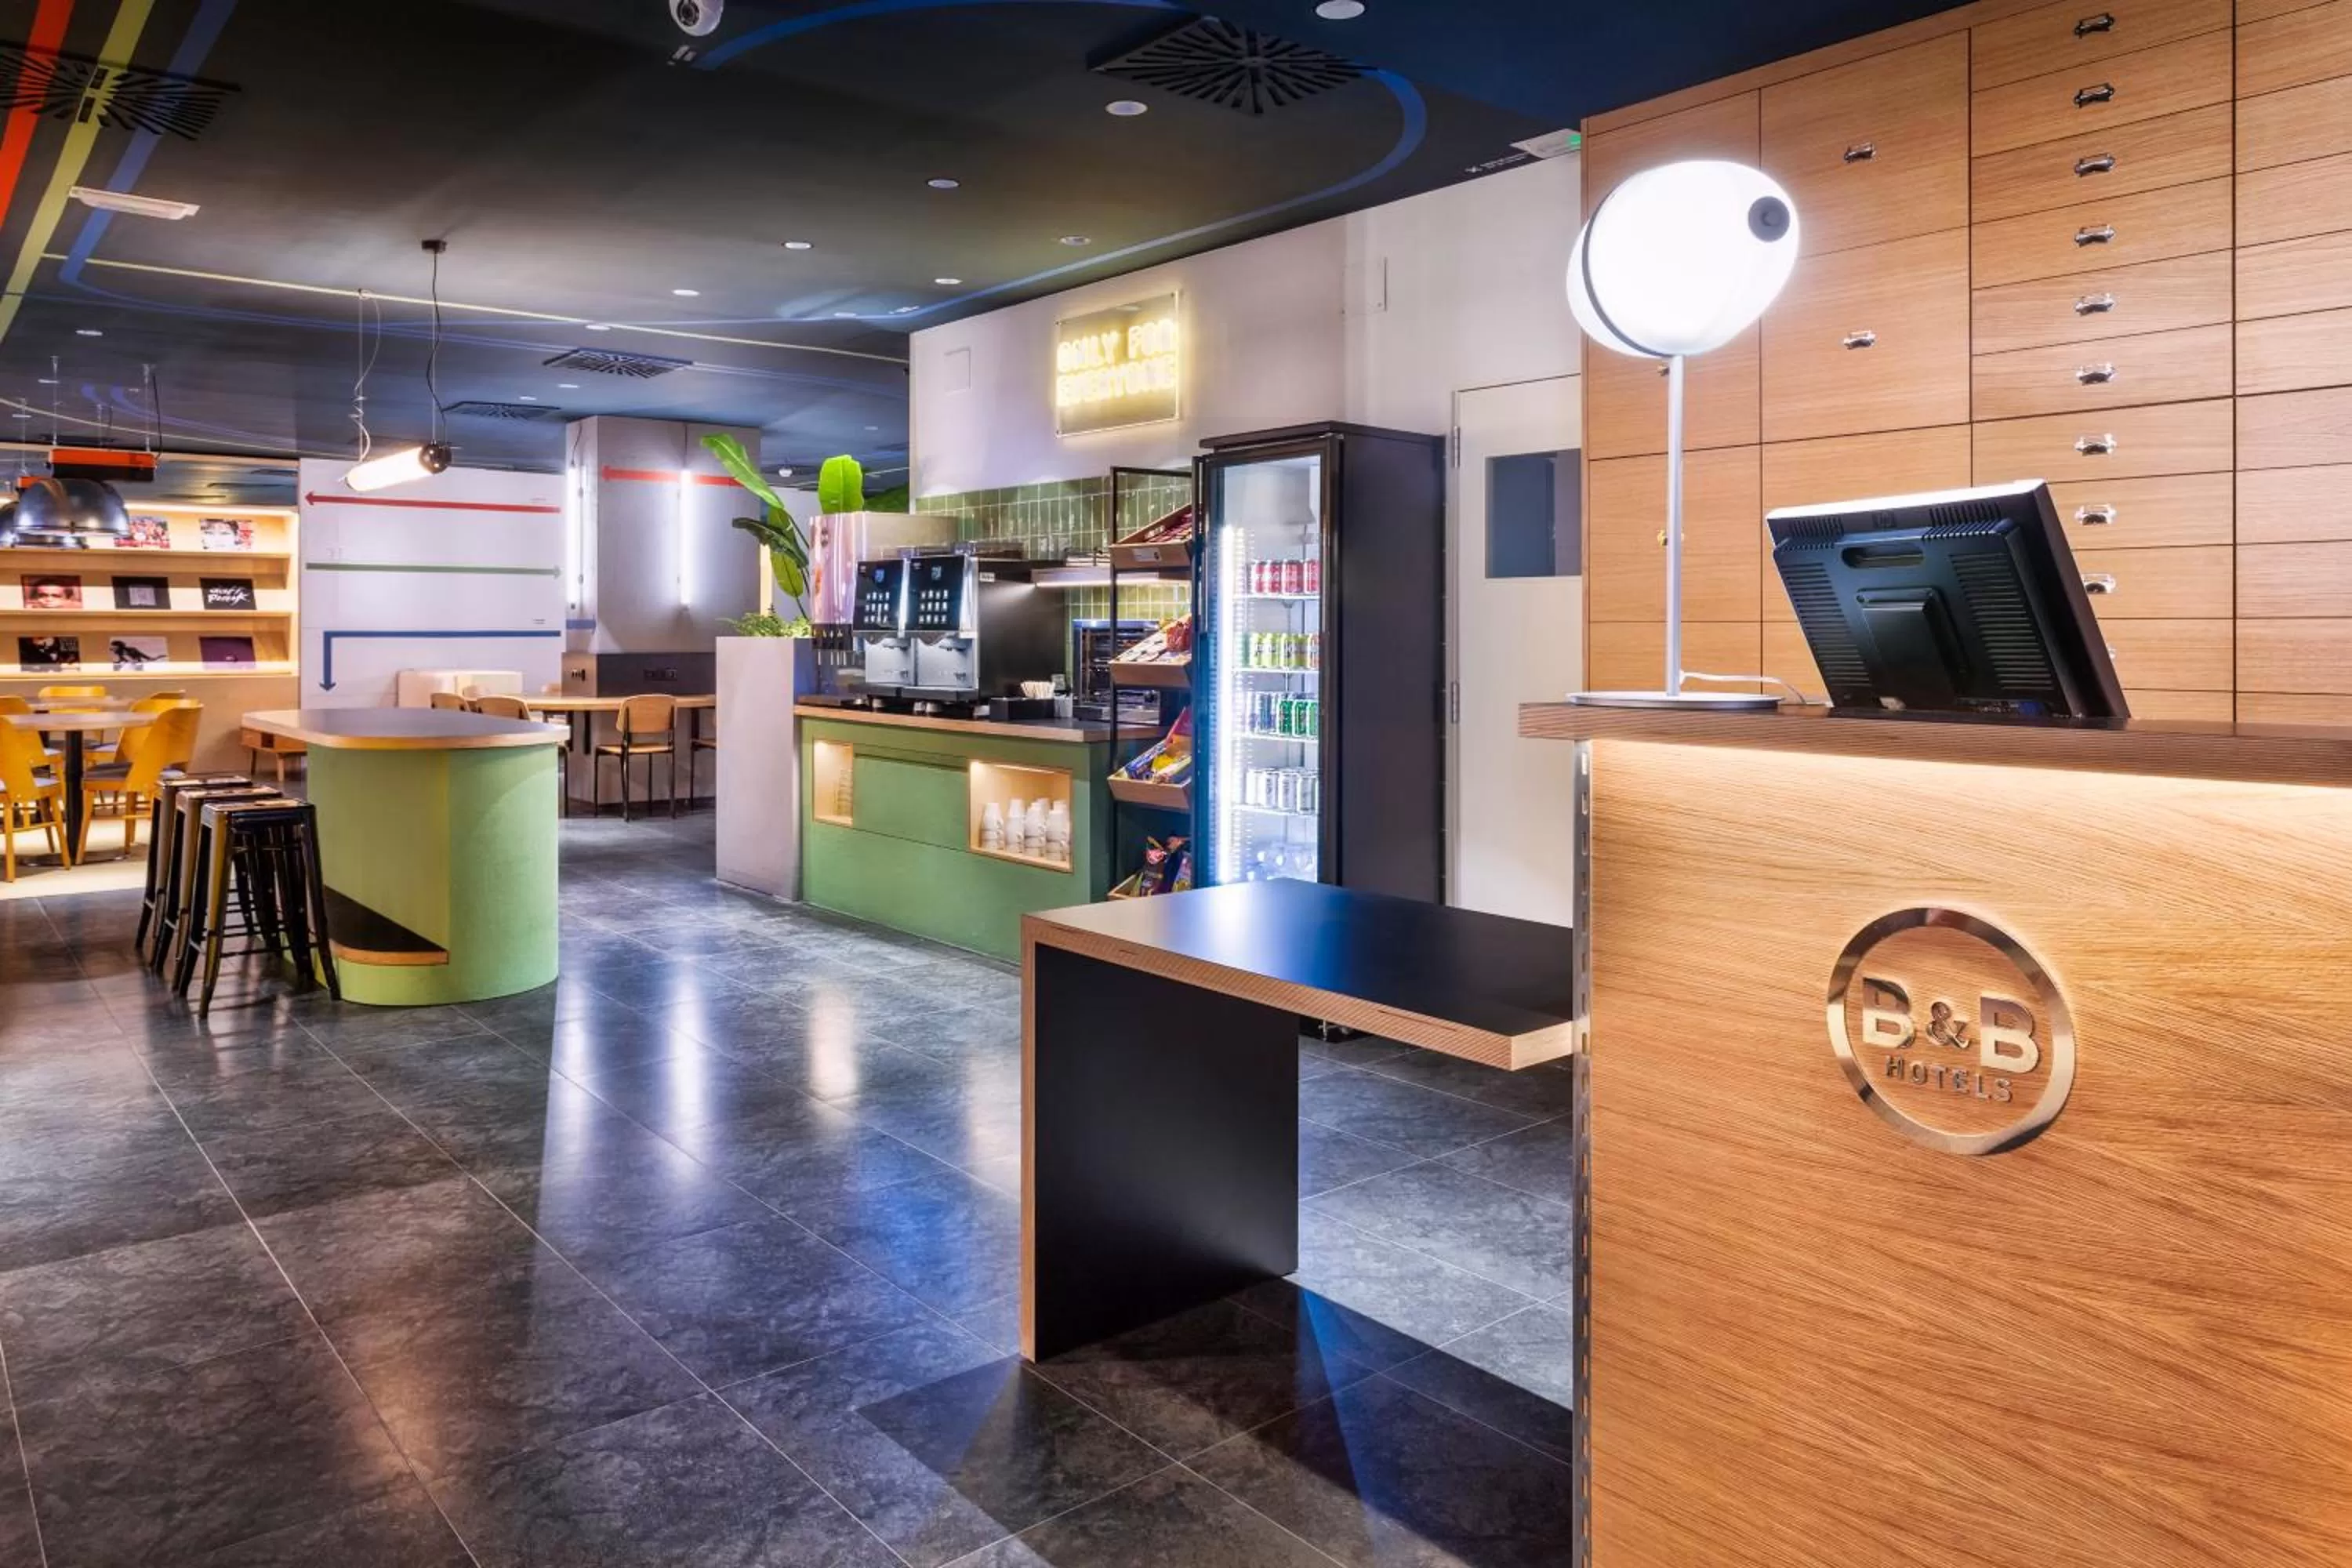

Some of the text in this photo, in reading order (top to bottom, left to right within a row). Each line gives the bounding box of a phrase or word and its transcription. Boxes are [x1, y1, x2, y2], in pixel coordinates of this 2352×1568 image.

[1057, 330, 1119, 372] ONLY
[1862, 976, 2040, 1074] B&B
[1885, 1054, 2013, 1102] HOTELS
